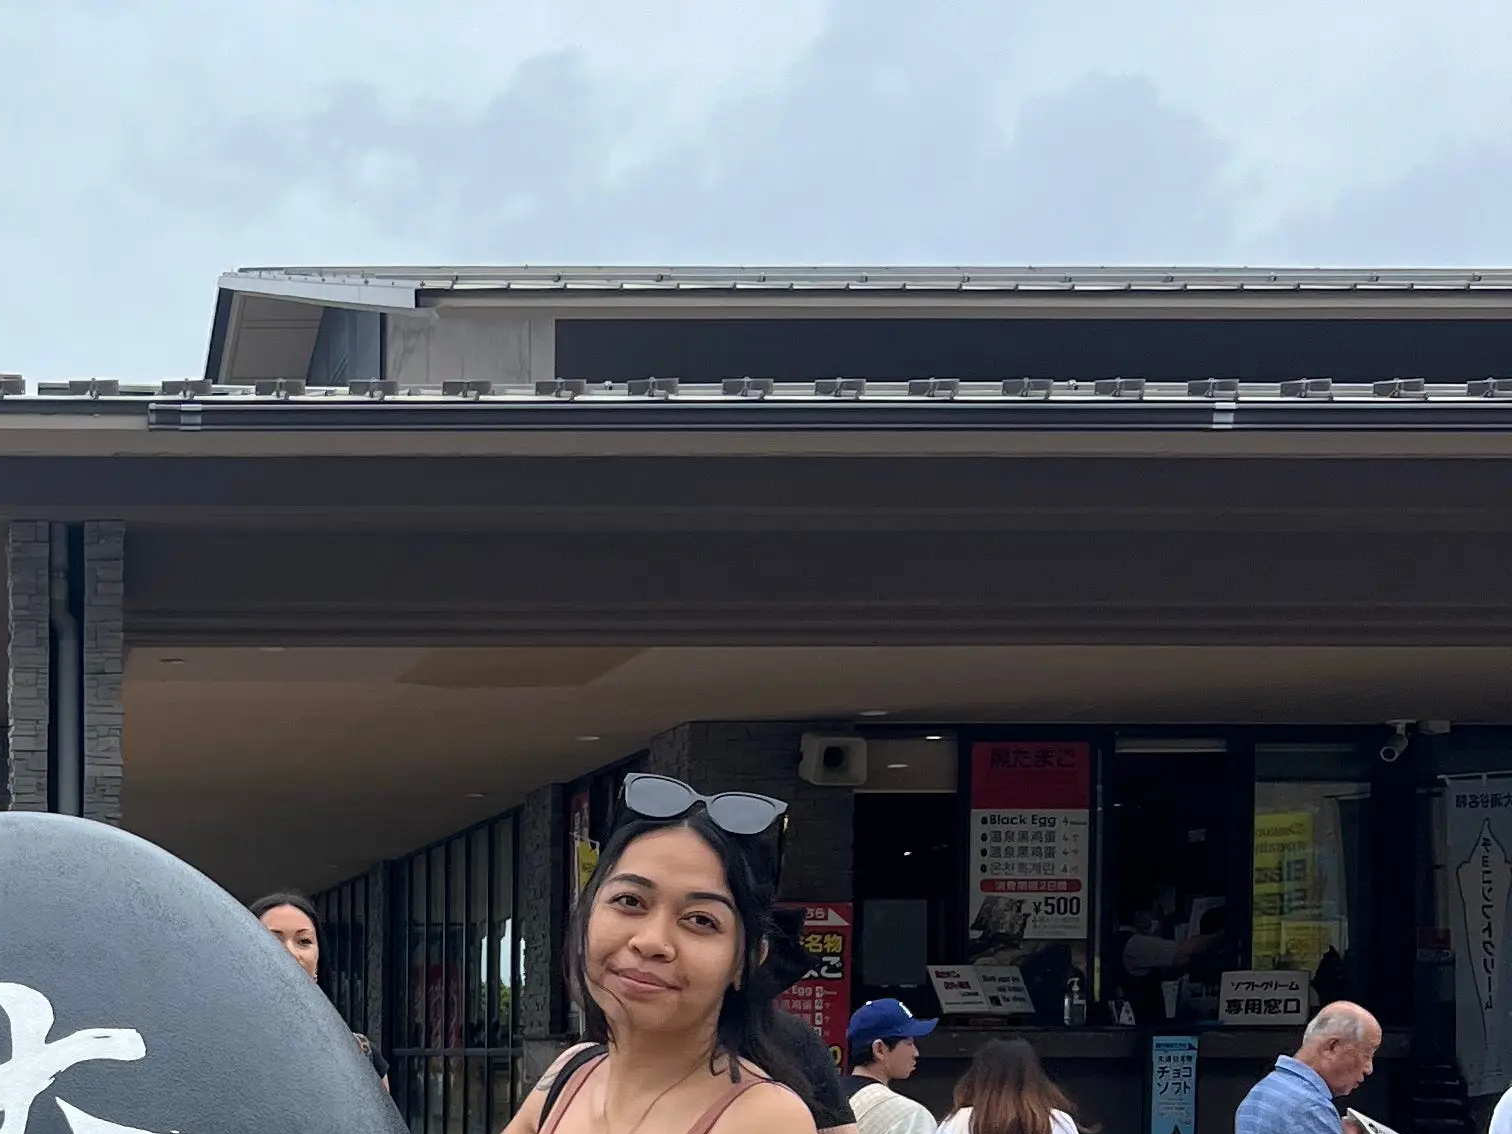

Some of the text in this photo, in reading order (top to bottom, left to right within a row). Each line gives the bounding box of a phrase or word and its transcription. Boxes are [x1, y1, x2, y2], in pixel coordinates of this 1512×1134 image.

[990, 815, 1027, 825] Black
[1031, 815, 1057, 828] Egg
[1033, 896, 1081, 916] ¥500
[805, 907, 826, 919] ちら
[804, 934, 842, 953] 名物
[792, 985, 812, 996] Egg
[1231, 981, 1299, 991] ソフトクリーム
[1225, 998, 1300, 1014] 専用窓口
[1157, 1066, 1192, 1079] チョコ
[1157, 1081, 1191, 1094] ソフト
